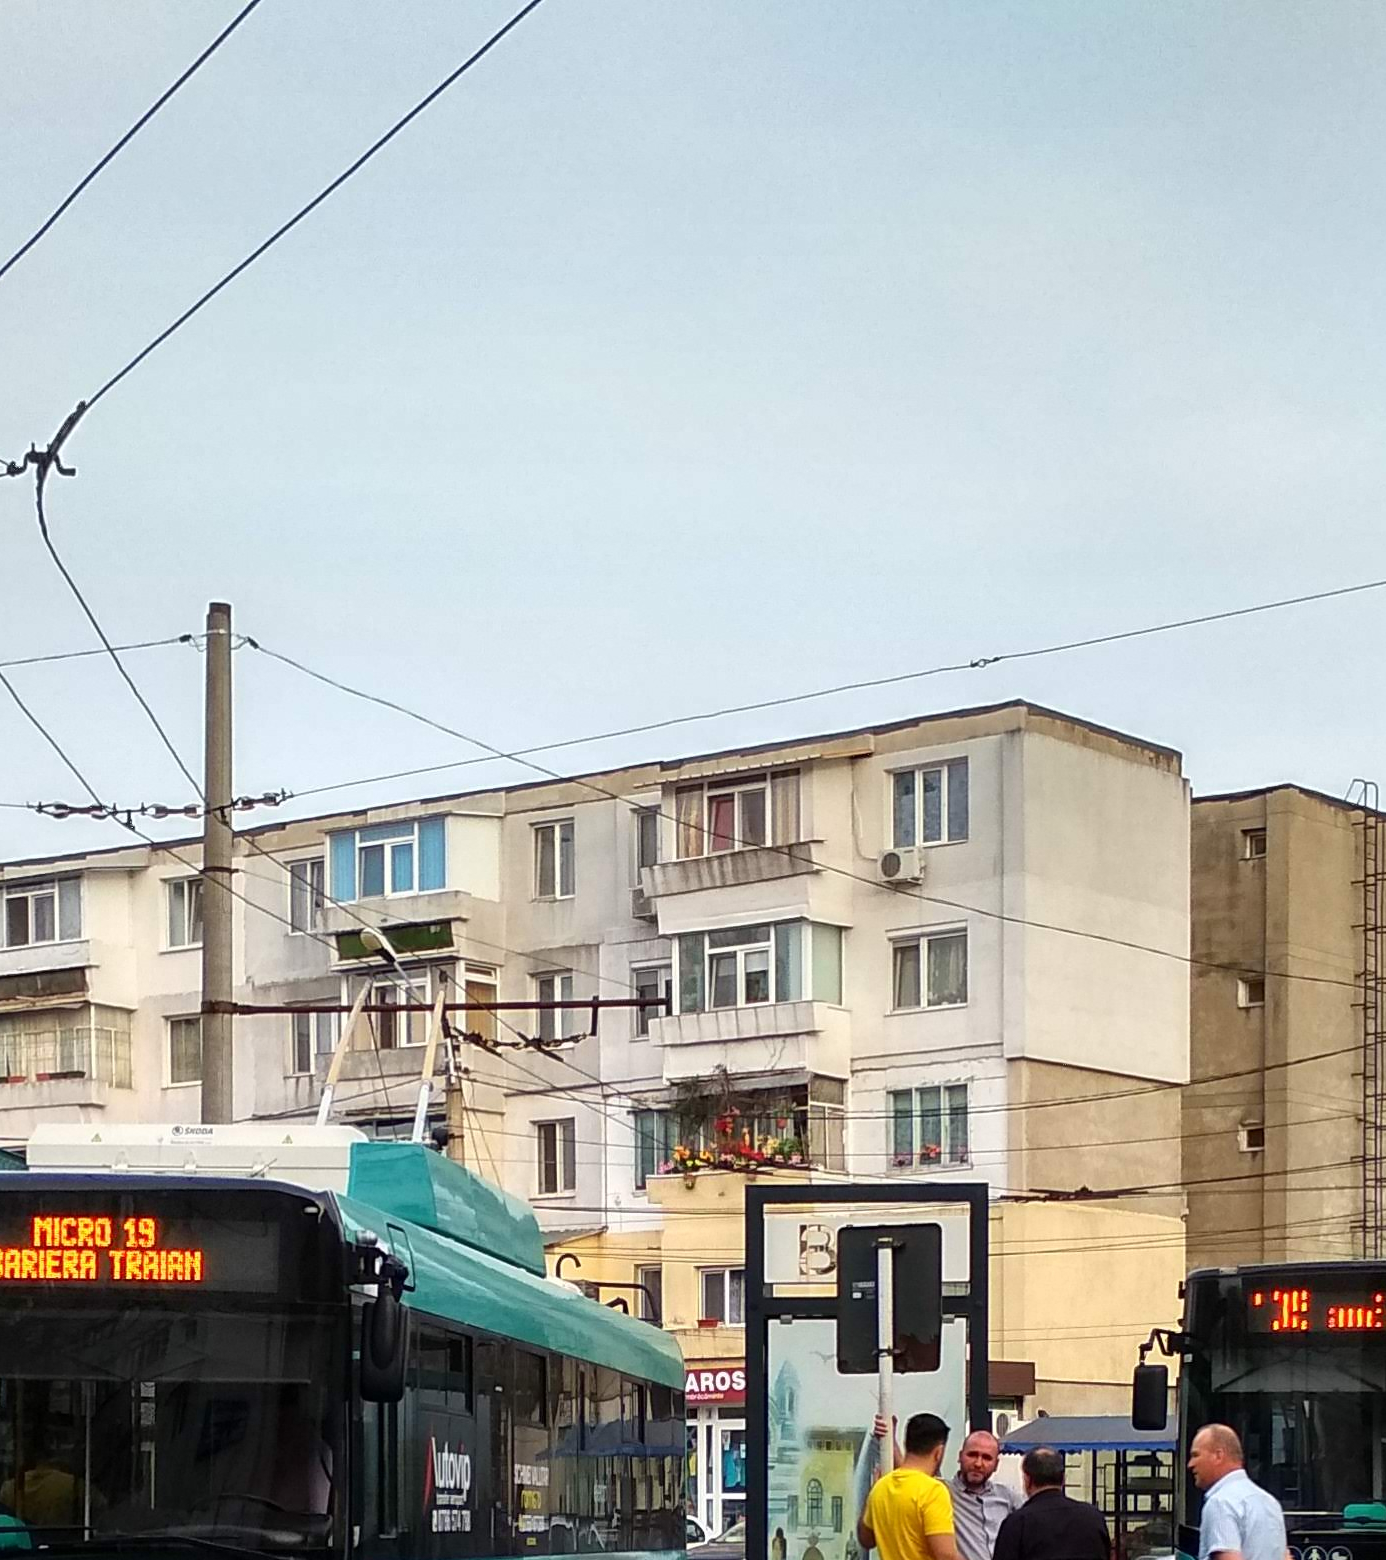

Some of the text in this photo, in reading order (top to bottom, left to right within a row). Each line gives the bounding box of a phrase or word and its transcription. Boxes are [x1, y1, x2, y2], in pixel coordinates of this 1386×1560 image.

[33, 1216, 156, 1249] MICRO 19
[109, 1250, 202, 1281] TRAIAN
